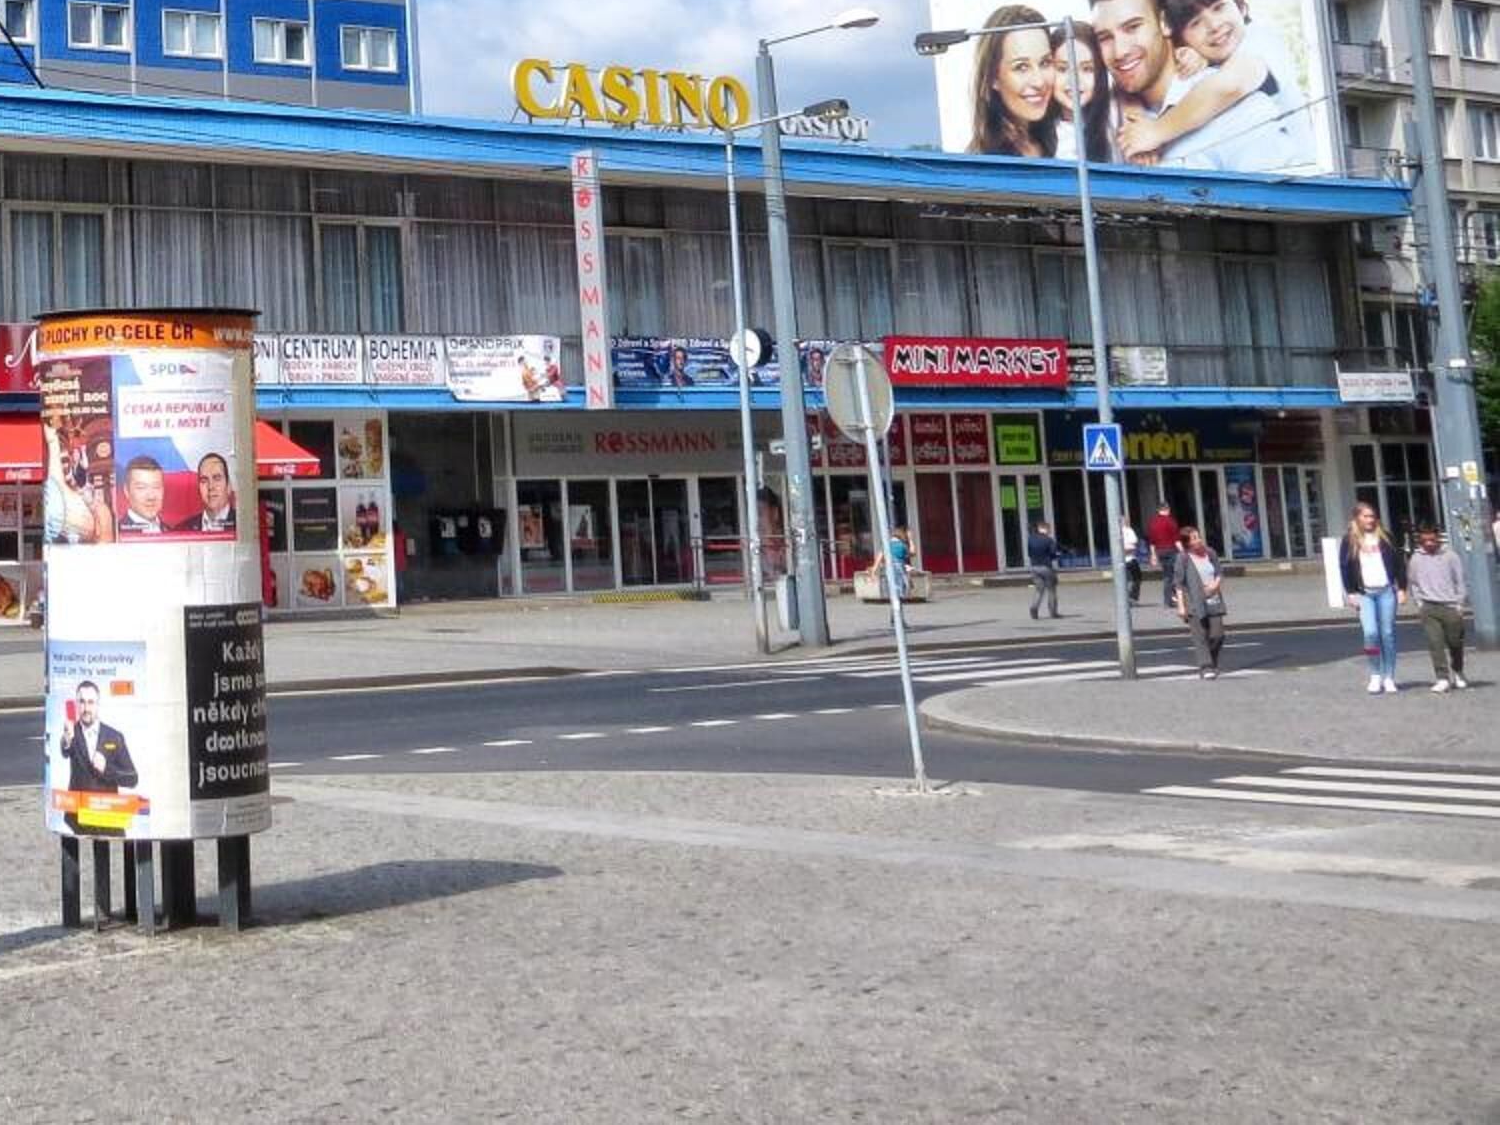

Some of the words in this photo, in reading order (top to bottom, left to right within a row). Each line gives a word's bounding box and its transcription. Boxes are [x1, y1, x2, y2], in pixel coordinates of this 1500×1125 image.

[512, 57, 751, 132] CASINO
[577, 157, 606, 406] ROSSMANN
[94, 324, 116, 341] PO
[283, 338, 358, 359] CENTRUM
[370, 340, 438, 360] BOHEMIA
[891, 344, 949, 375] MINI
[952, 345, 1061, 378] MARKET
[149, 362, 177, 376] SPD
[595, 430, 717, 454] ROSSMANN
[213, 672, 253, 697] jsme
[193, 699, 249, 724] někdy
